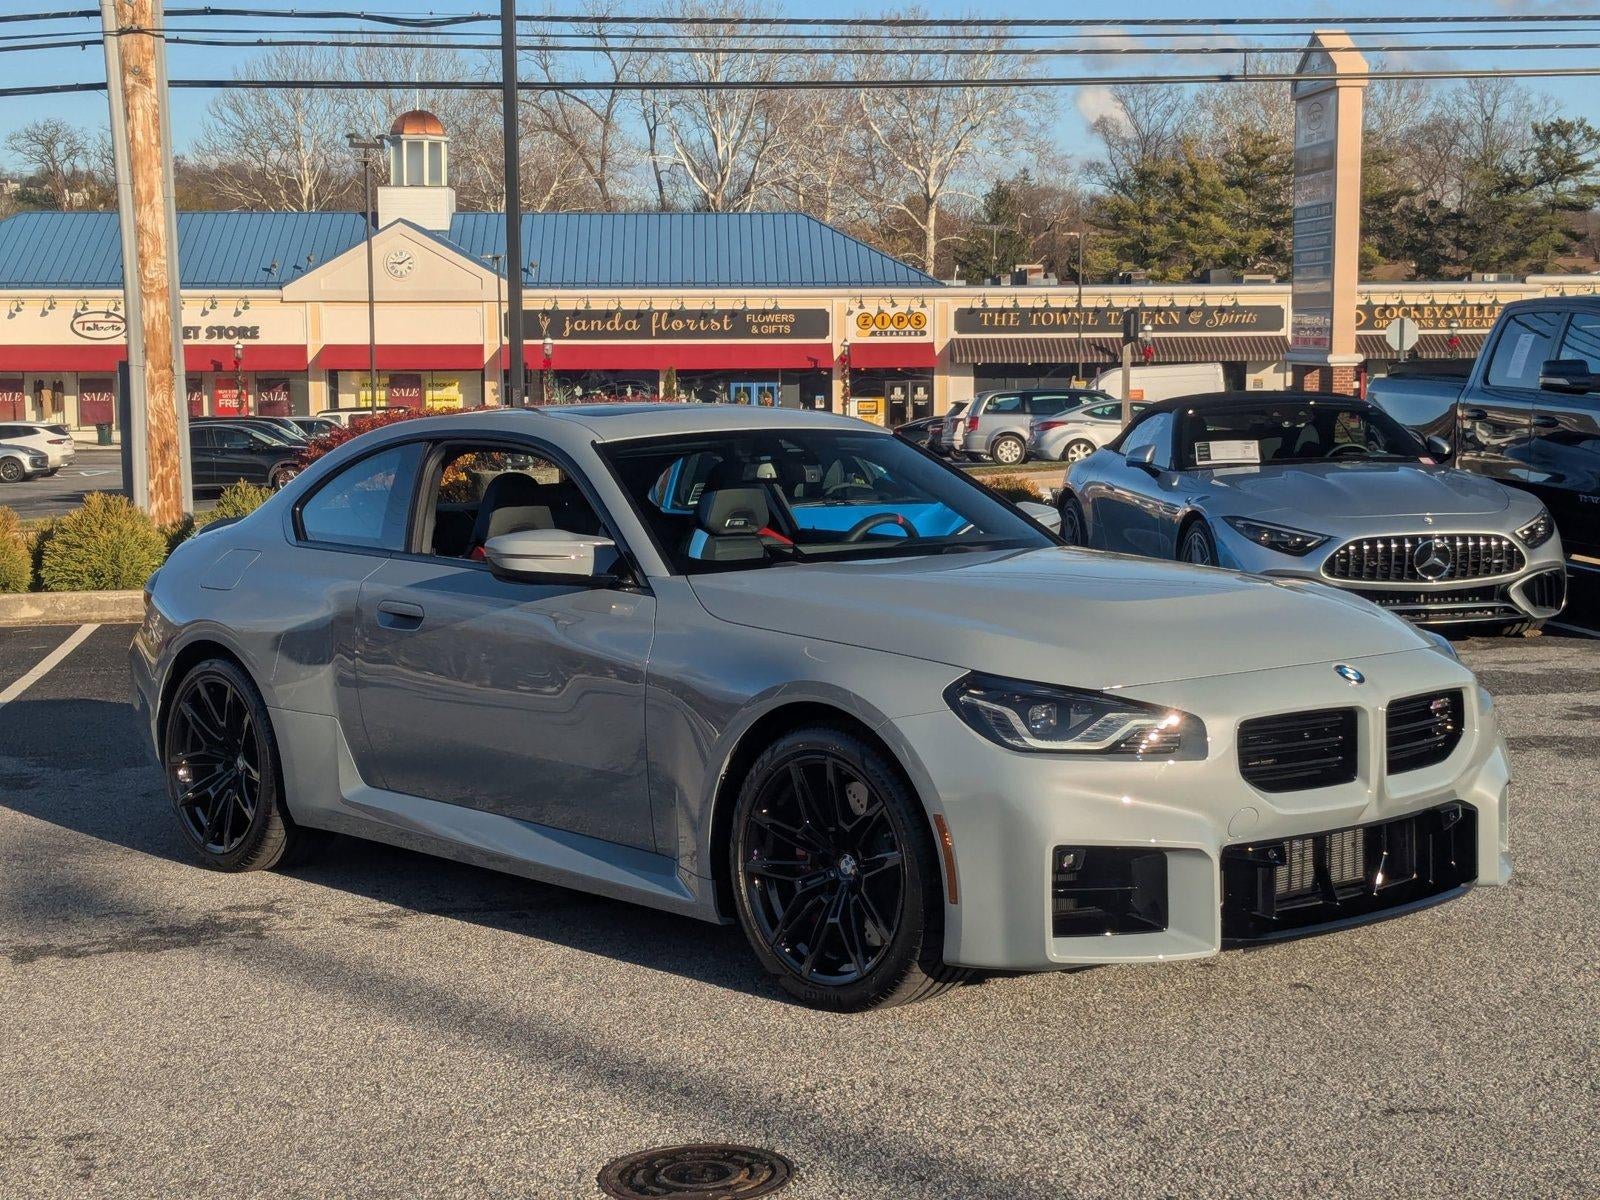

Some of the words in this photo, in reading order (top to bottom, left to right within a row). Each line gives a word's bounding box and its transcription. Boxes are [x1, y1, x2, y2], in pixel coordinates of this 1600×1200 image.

[746, 313, 796, 323] FLOWERS
[979, 311, 1020, 326] THE
[1028, 311, 1099, 326] TOWNE
[1187, 311, 1203, 325] &
[1205, 309, 1259, 328] Spirits
[1438, 319, 1447, 328] &
[75, 319, 123, 332] Talbots
[562, 313, 641, 337] janda
[651, 312, 733, 336] florist
[751, 325, 759, 334] &
[761, 325, 791, 334] GIFTS
[205, 326, 260, 340] STORE
[0, 391, 23, 402] ALE
[82, 391, 112, 402] SALE
[260, 391, 289, 402] SALE
[391, 386, 420, 398] SALE
